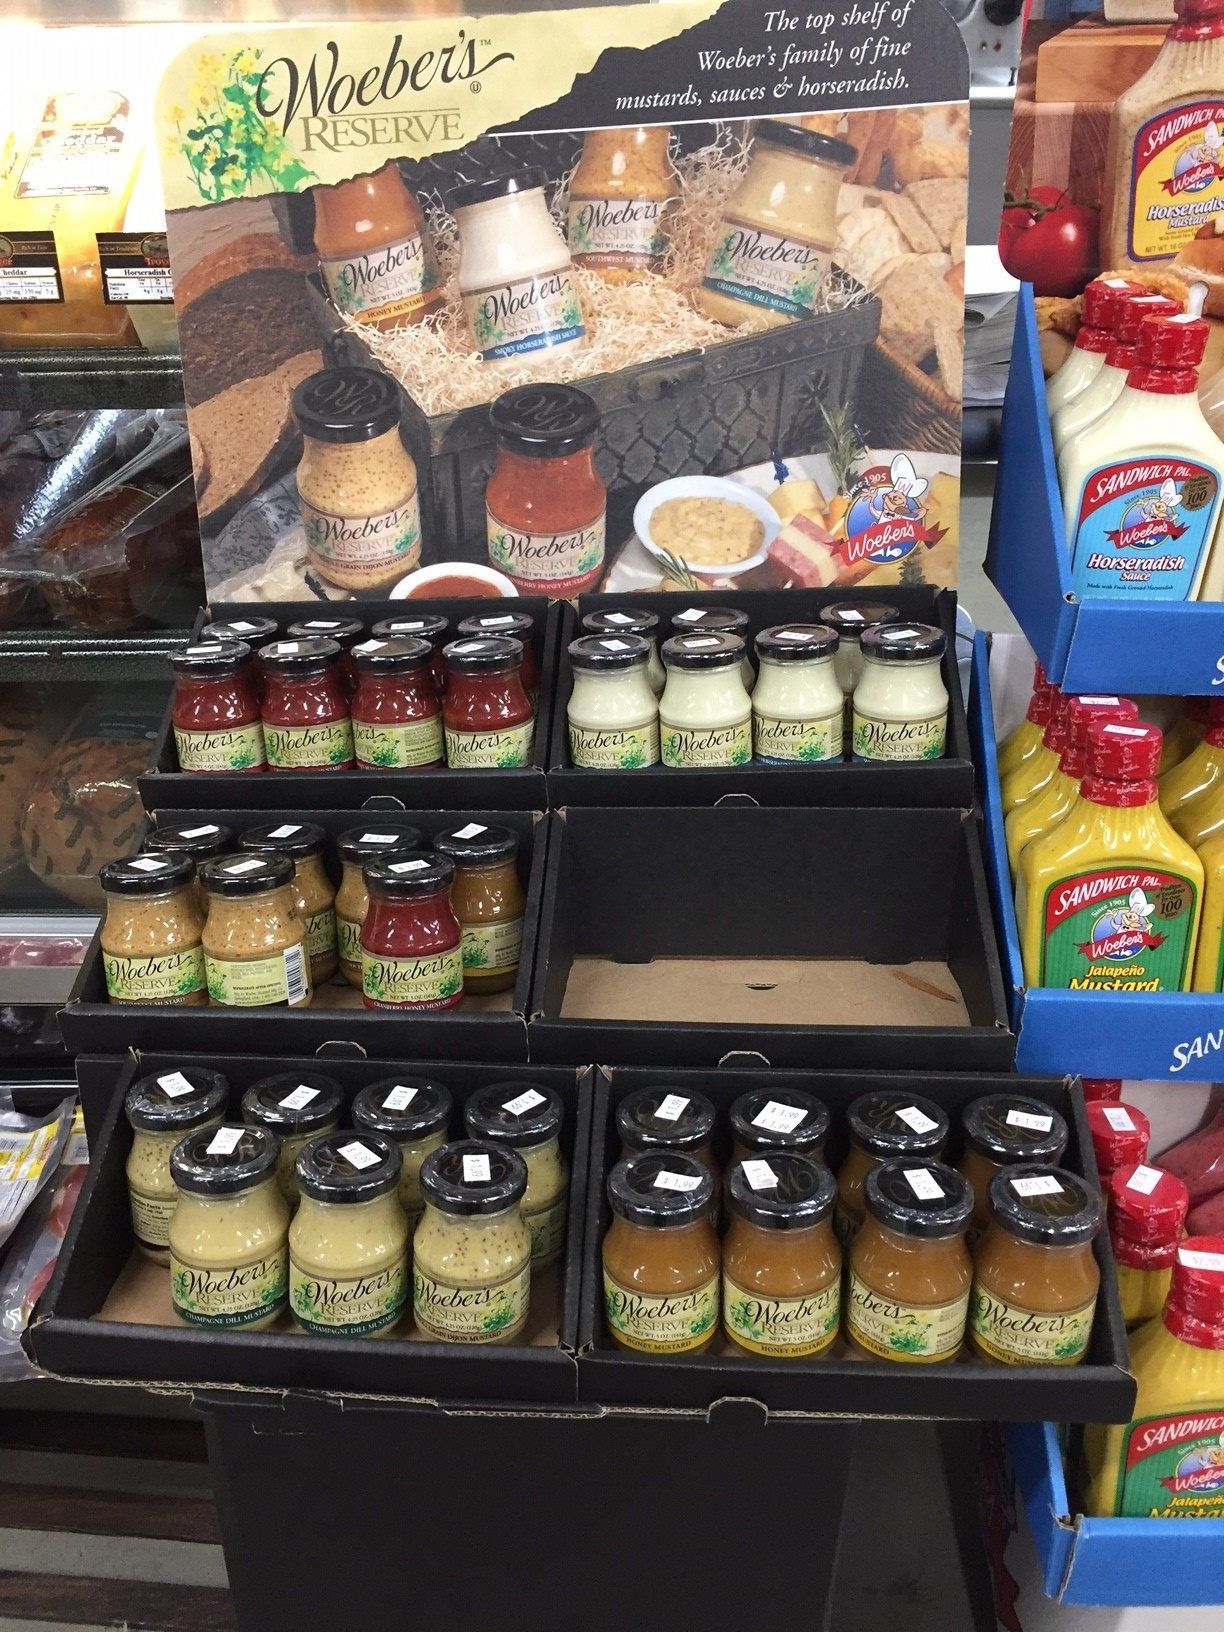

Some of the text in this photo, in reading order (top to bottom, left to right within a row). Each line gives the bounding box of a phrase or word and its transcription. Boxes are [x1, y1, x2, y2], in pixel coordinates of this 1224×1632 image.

[763, 0, 915, 34] The top shelf of
[698, 36, 912, 72] Woeber's family of fine
[256, 30, 515, 137] Woeber's
[615, 69, 910, 110] mustards, sauces & horseradish.
[300, 112, 465, 153] RESERVE
[1143, 106, 1212, 157] SANDWICH
[1172, 163, 1215, 194] Woeber's
[580, 199, 659, 233] Woeber's
[1168, 214, 1210, 230] Mustard
[727, 231, 819, 266] Woeber's
[343, 239, 424, 290] Woeber's
[367, 296, 426, 318] HONEY MUSTARD
[717, 281, 753, 299] CHAMPAGNE
[770, 298, 798, 312] MUSTARD
[865, 472, 886, 486] 1905
[1089, 464, 1172, 503] SANDWICH
[1186, 490, 1207, 506] 100
[316, 508, 409, 541] Woeber's
[1119, 522, 1169, 546] Woeber's
[501, 530, 595, 560] Woeber's
[847, 521, 915, 562] Woeber's
[1087, 553, 1185, 571] Horseradish
[1119, 571, 1152, 582] Sauce
[177, 731, 244, 754] Woeber's
[272, 726, 341, 752] Woeber's
[354, 723, 386, 740] ber's
[450, 732, 511, 753] Woeber's
[571, 729, 636, 750] Woeber's
[672, 727, 744, 753] Woeber's
[863, 721, 938, 744] Woeber's
[873, 741, 924, 752] RESERVE
[1054, 875, 1137, 916] SANDWICH
[1160, 898, 1183, 915] 100
[1091, 899, 1126, 918] Since 1905
[1091, 932, 1144, 959] Woeber's
[110, 953, 192, 981] Woeber's
[373, 955, 454, 985] Woeber's
[1085, 965, 1145, 979] Jalapeño
[121, 976, 177, 991] RESERVE
[384, 979, 439, 994] RESERVE
[1069, 977, 1160, 992] Mustard
[1169, 1028, 1224, 1073] SAN
[779, 1108, 799, 1119] 1.99
[673, 1179, 695, 1189] 1.99
[181, 1259, 278, 1296] Woeber's
[306, 1268, 399, 1306] Woeber's
[195, 1289, 260, 1306] RESERVE
[416, 1275, 504, 1307] Woeber's
[851, 1288, 916, 1319] oeber's
[185, 1311, 224, 1324] CHAMPAGNE
[243, 1304, 275, 1320] MUSTARD
[321, 1298, 384, 1317] RESERVE
[613, 1292, 708, 1319] Woeber's
[745, 1287, 838, 1325] Woeber's
[979, 1296, 1078, 1333] Woeber's
[308, 1312, 396, 1334] CHAMPAGNE DILL MUSTARD
[626, 1313, 690, 1332] RESERVE
[447, 1332, 469, 1342] DIJON
[469, 1330, 502, 1342] MUSTARD
[625, 1337, 692, 1350] HONEY MUSTARD
[761, 1339, 825, 1354] HONEY MUSTARD
